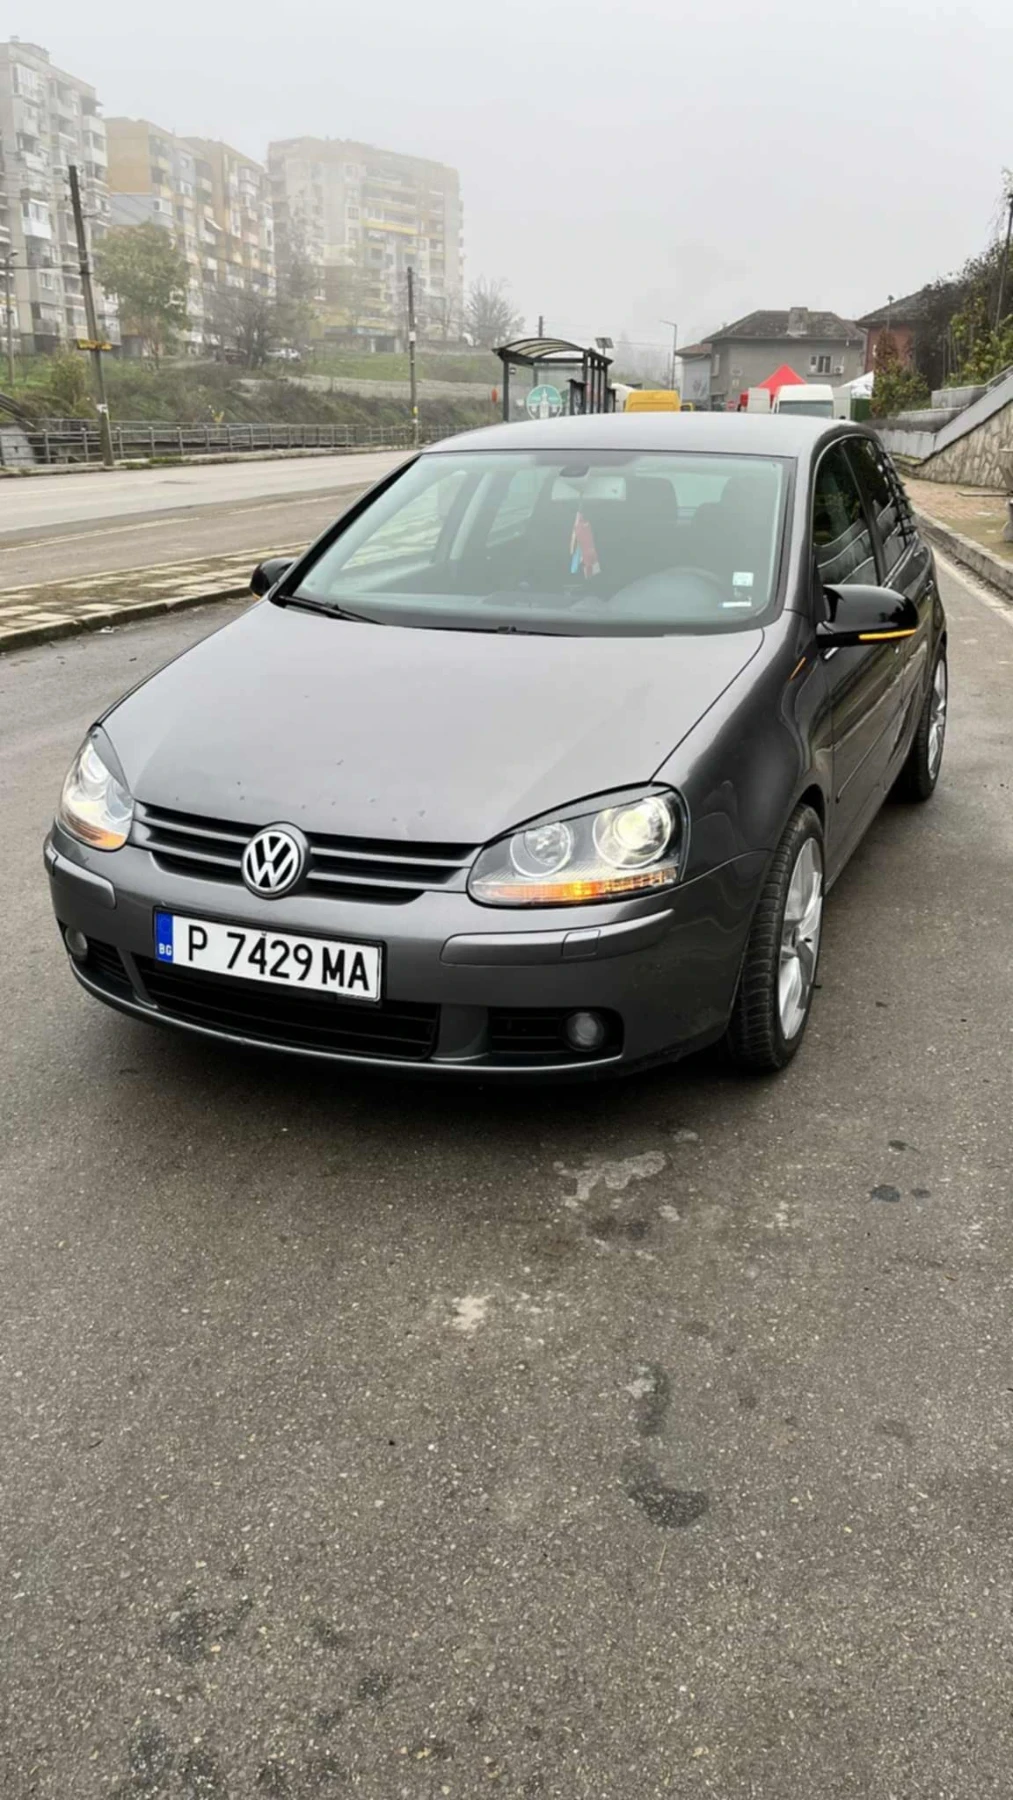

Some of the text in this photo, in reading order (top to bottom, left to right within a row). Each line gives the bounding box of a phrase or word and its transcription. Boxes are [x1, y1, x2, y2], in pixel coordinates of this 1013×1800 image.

[245, 833, 298, 890] VW
[159, 943, 172, 956] BG
[188, 925, 370, 991] P 7429 MA
